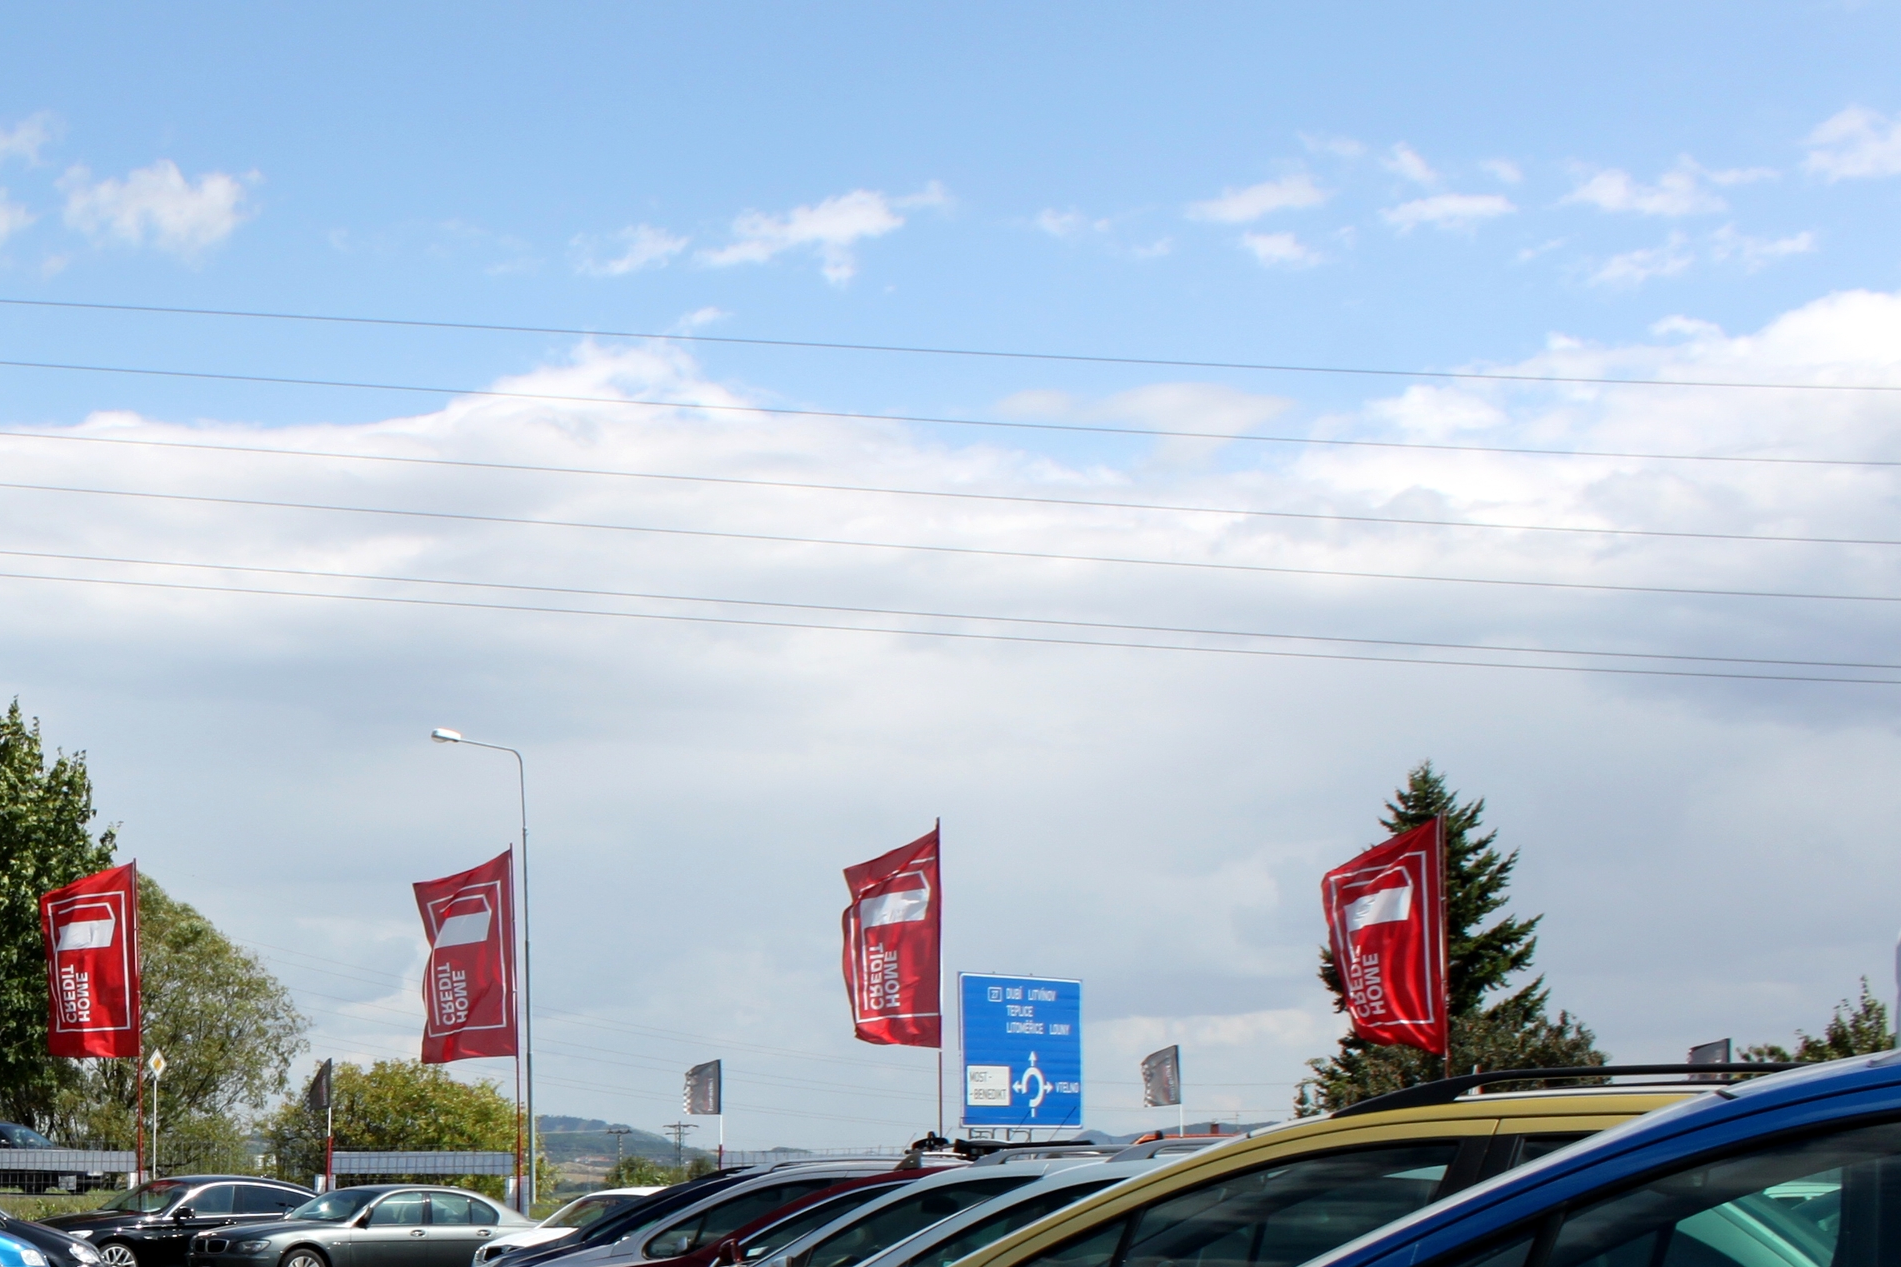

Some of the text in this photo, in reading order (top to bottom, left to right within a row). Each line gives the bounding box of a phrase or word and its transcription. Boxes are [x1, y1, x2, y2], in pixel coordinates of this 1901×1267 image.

[1006, 985, 1023, 1000] DUBÍ
[1028, 987, 1056, 1001] LITVÍNOV
[1006, 1004, 1034, 1017] TEPLICE
[1006, 1020, 1070, 1035] LITOMĚŘICE LOUNY
[1055, 1081, 1079, 1094] VTELNO
